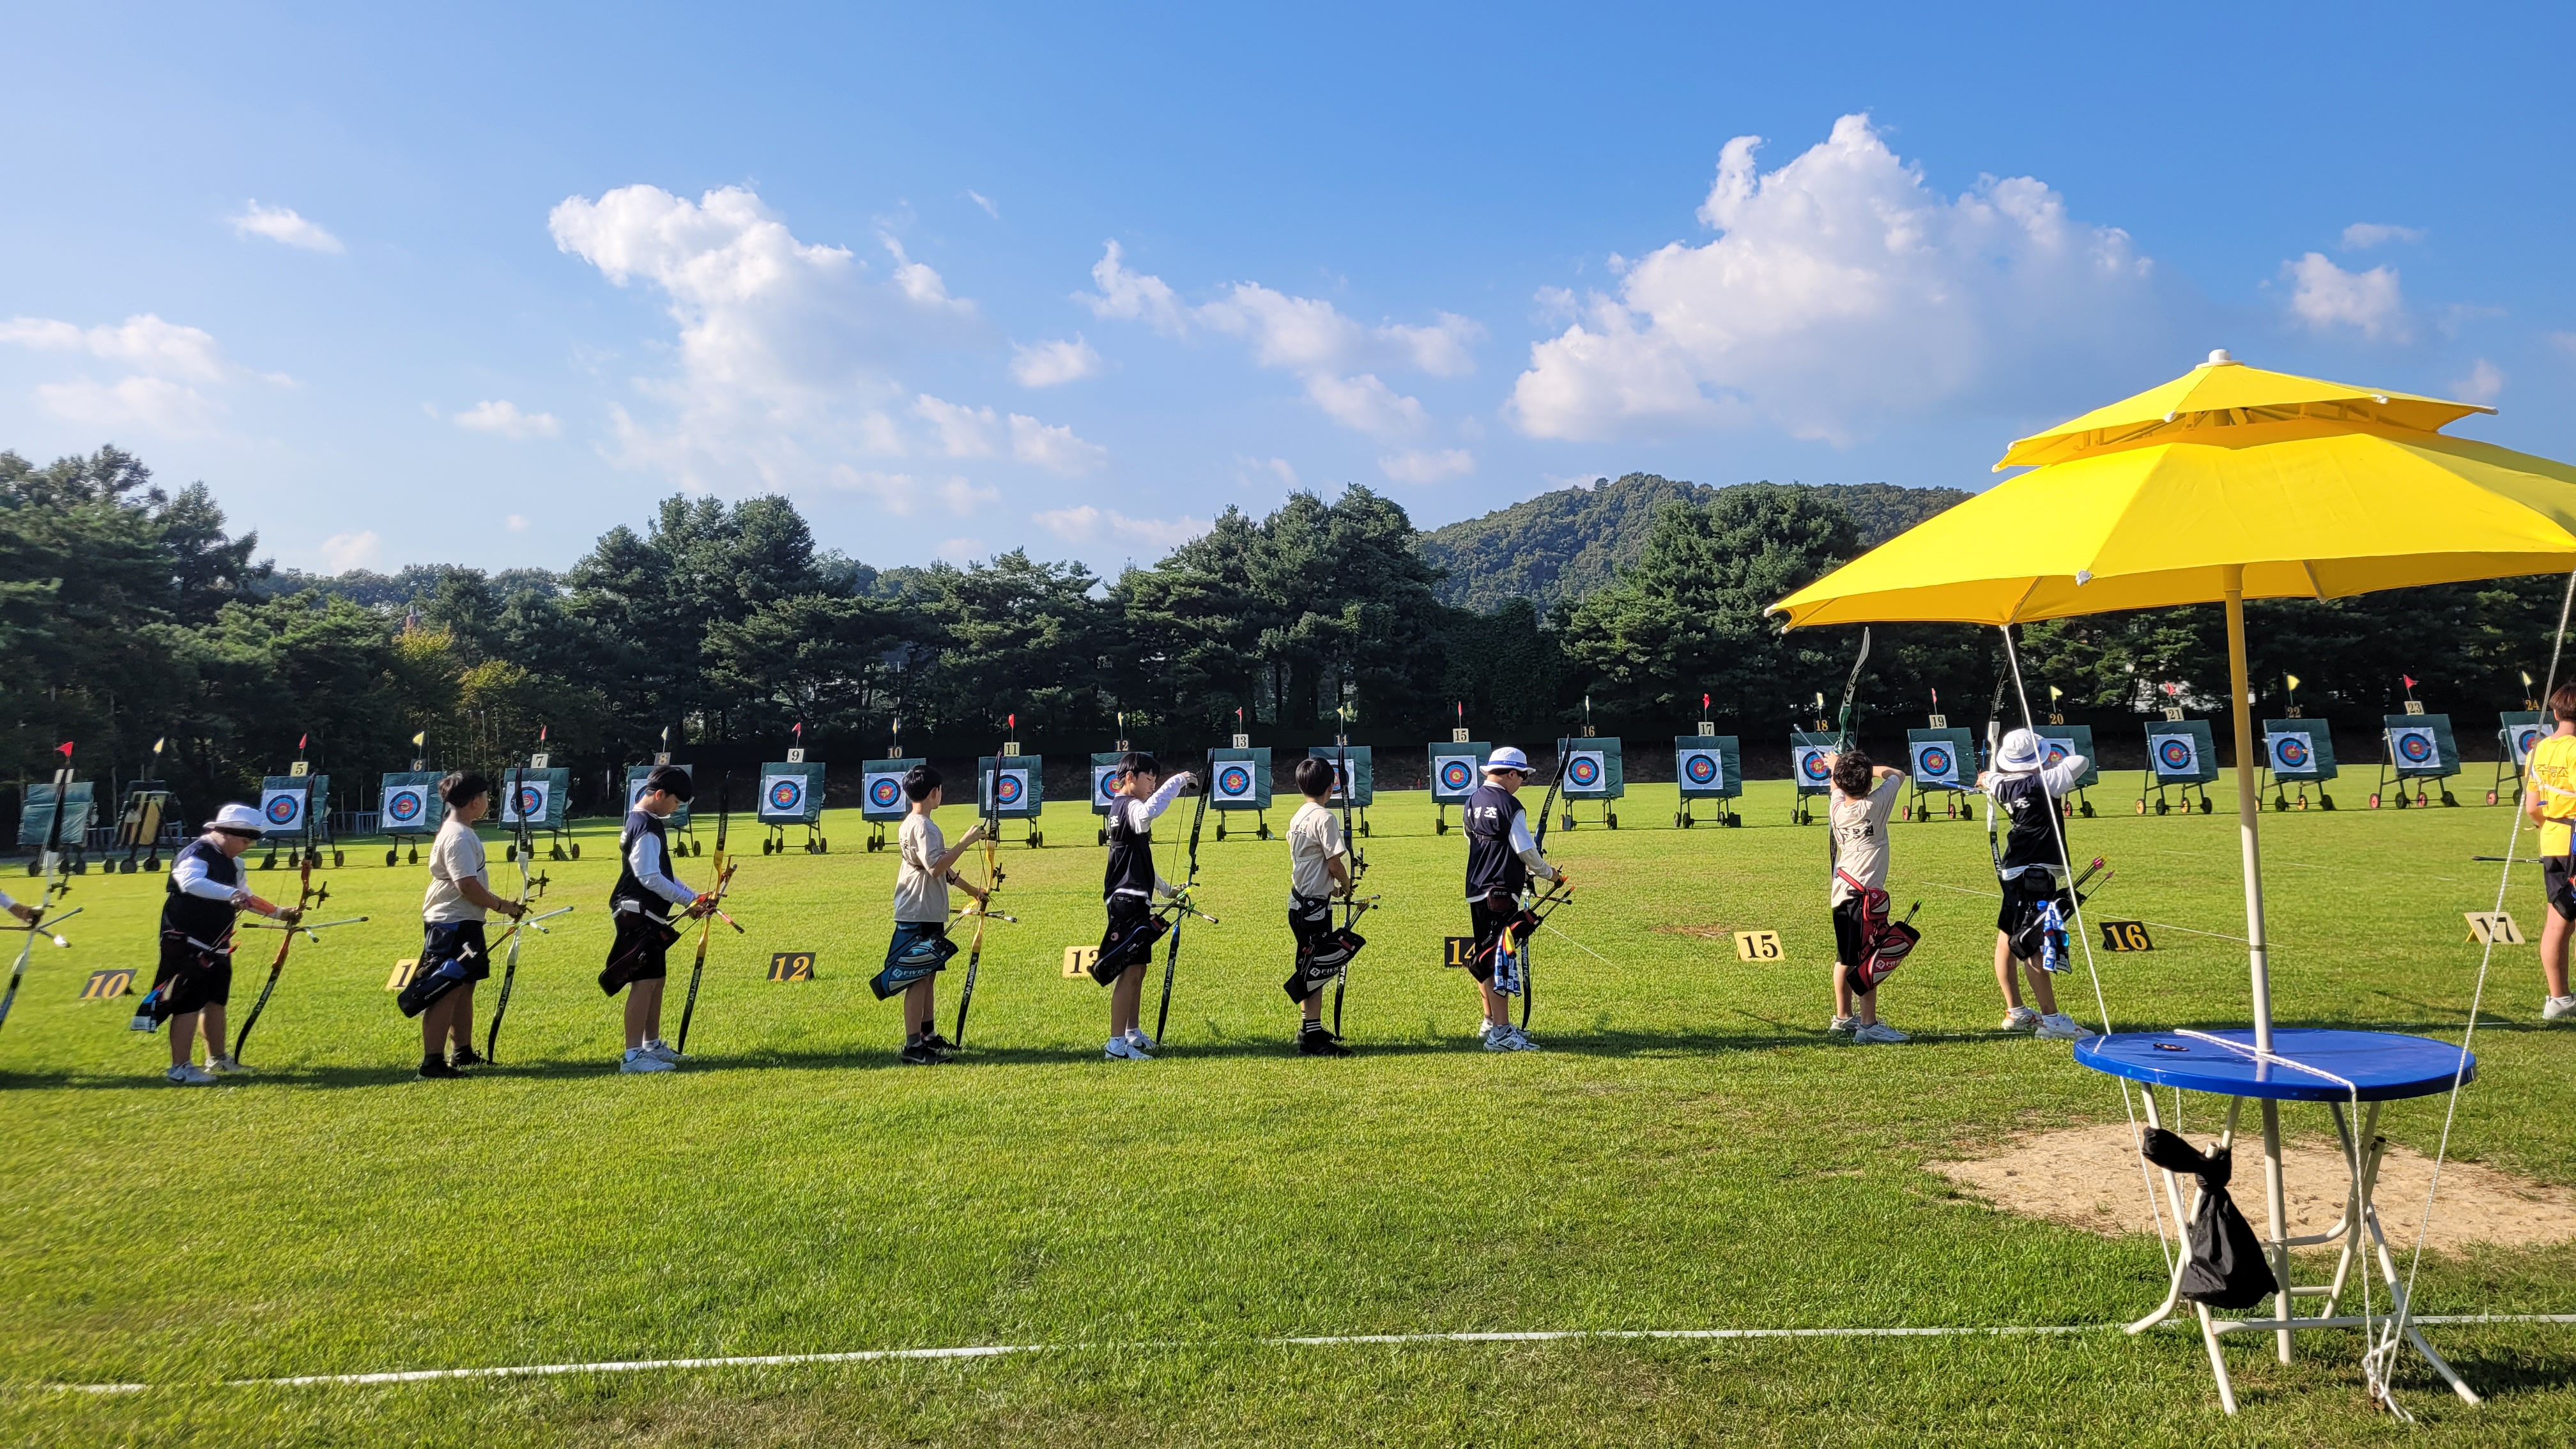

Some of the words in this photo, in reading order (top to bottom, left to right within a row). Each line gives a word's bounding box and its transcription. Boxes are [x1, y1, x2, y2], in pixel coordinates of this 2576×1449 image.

[2407, 703, 2421, 714] 23
[2526, 700, 2540, 710] 24
[2168, 709, 2182, 720] 21
[2287, 707, 2301, 717] 22
[1931, 716, 1944, 727] 19
[2049, 713, 2064, 725] 20
[1583, 725, 1595, 737] 16
[1701, 723, 1712, 735] 17
[1816, 719, 1828, 732] 18
[1234, 736, 1246, 747] 13
[1335, 735, 1348, 746] 14
[1455, 730, 1467, 741] 15
[1006, 744, 1019, 755] 11
[1116, 740, 1129, 752] 12
[792, 750, 800, 762] 9
[888, 747, 903, 759] 10
[536, 756, 544, 767] 7
[658, 755, 667, 764] 8
[295, 763, 304, 775] 5
[413, 760, 422, 772] 6
[2475, 917, 2515, 944] 17
[2106, 924, 2148, 951] 16
[1742, 934, 1779, 959] 15
[774, 955, 810, 982] 12
[399, 962, 414, 995] 1
[80, 972, 130, 1000] 10
